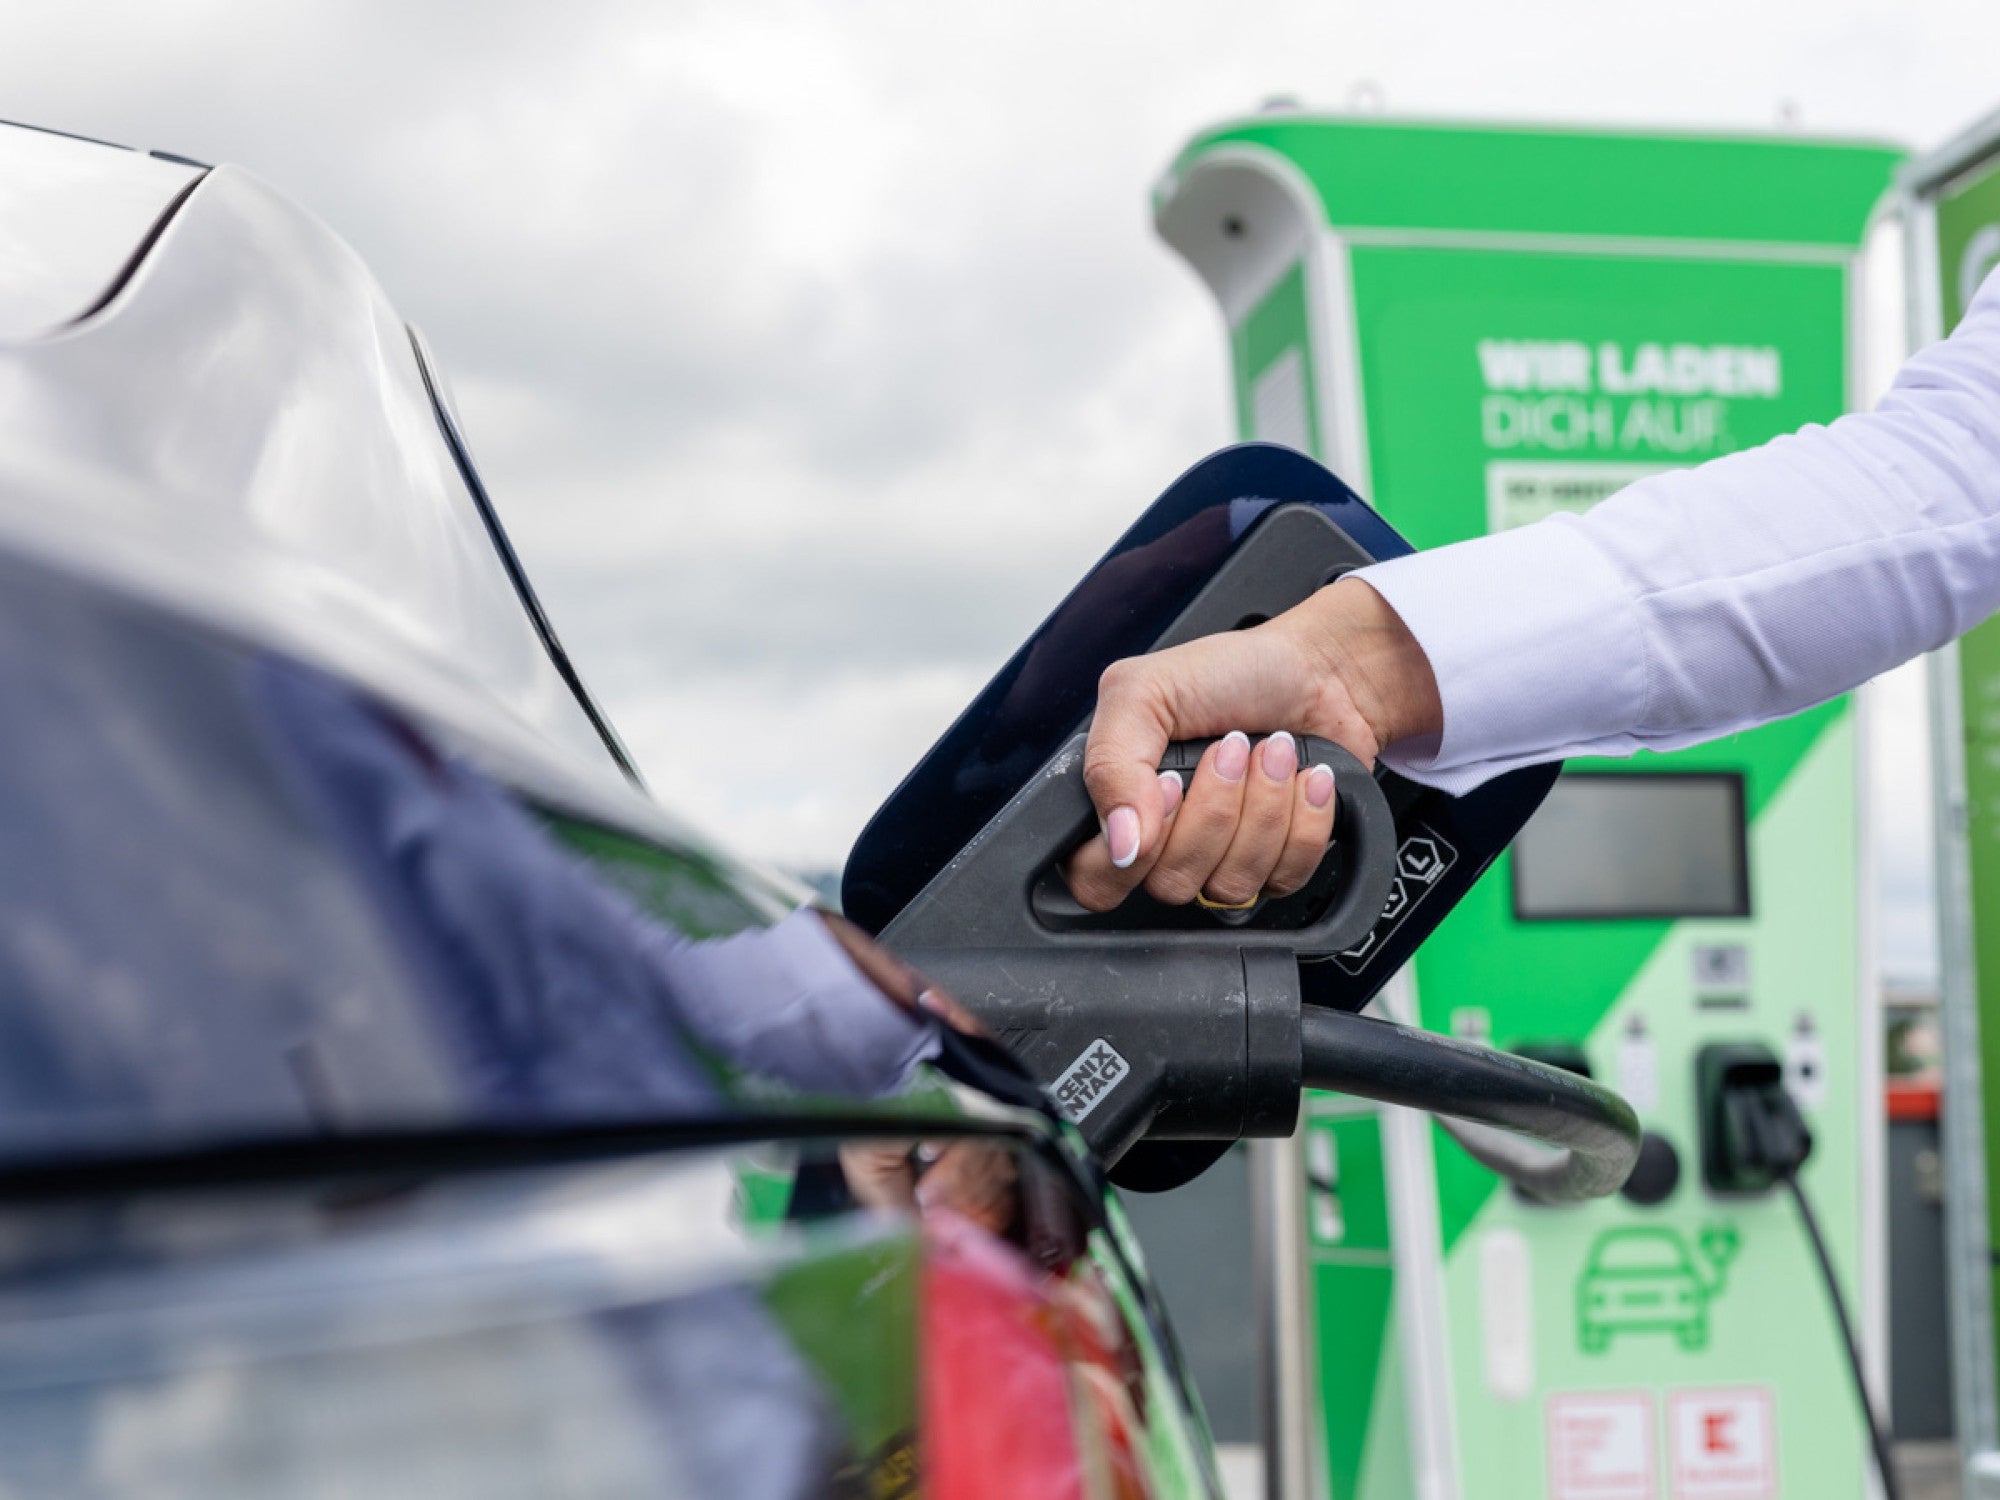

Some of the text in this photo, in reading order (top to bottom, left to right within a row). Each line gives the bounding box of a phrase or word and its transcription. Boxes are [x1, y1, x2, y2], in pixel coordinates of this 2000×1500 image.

[1479, 341, 1780, 398] WIR LADEN
[1482, 395, 1612, 449] DICH
